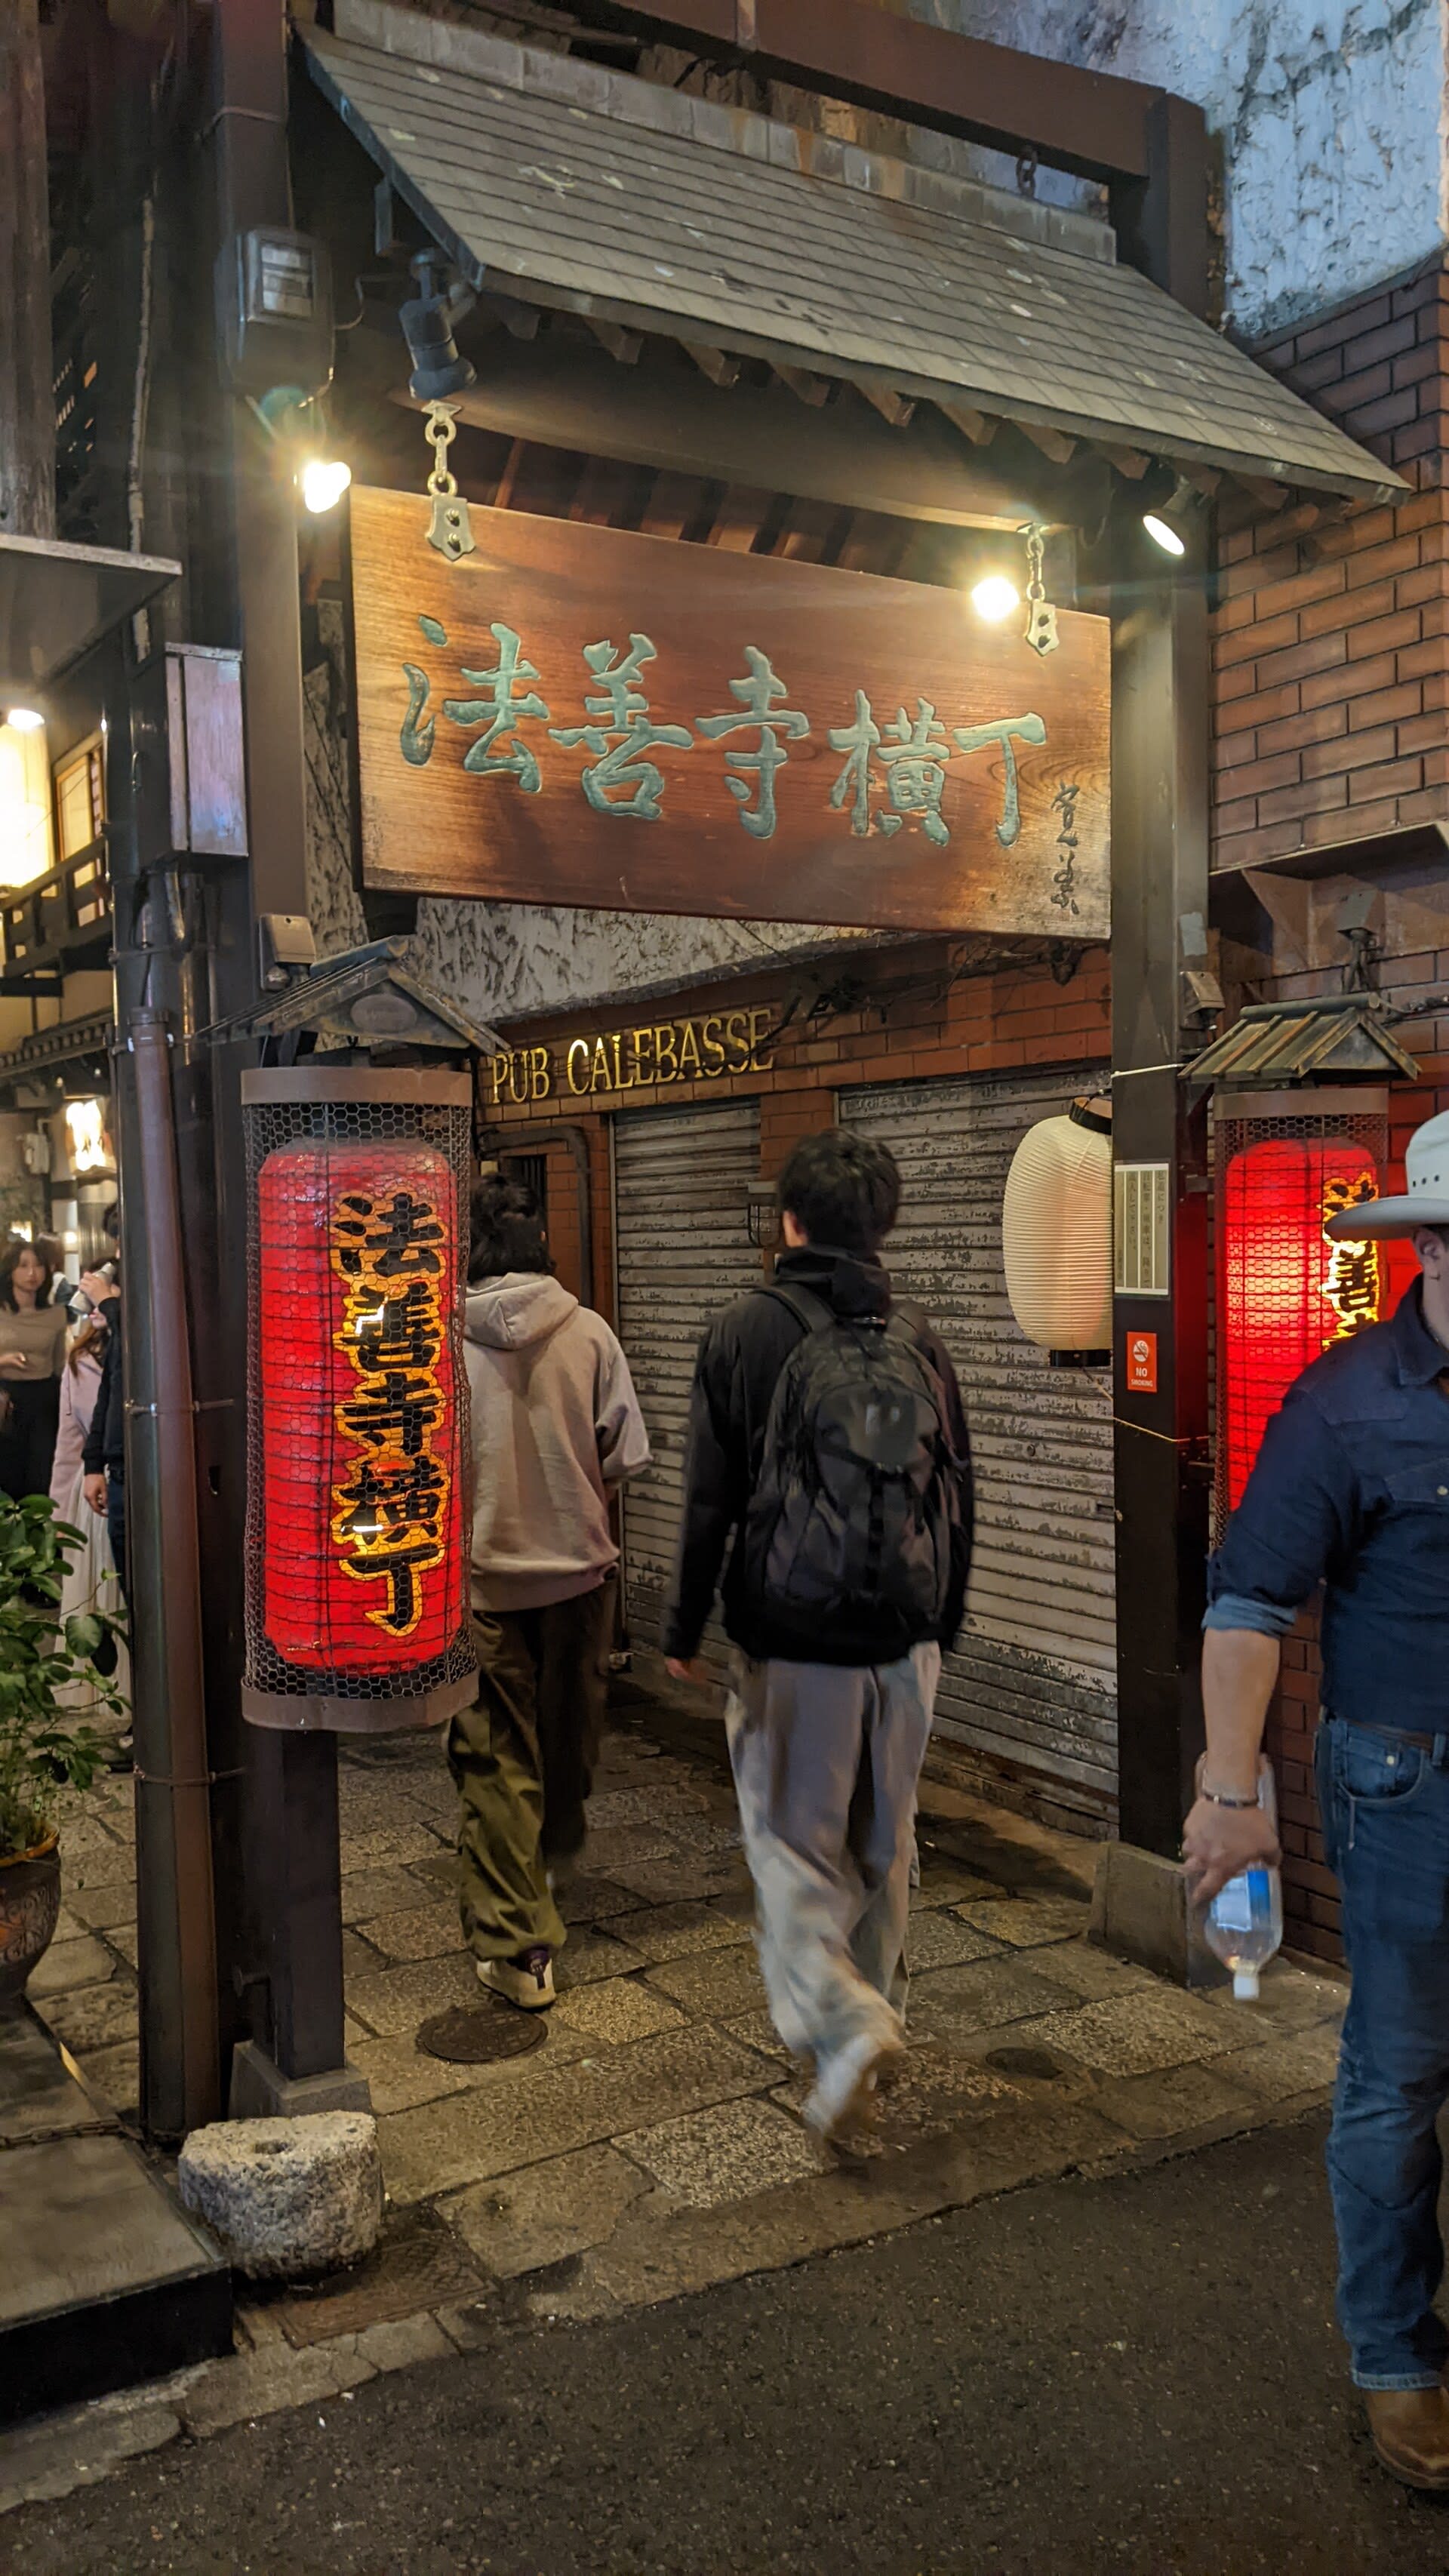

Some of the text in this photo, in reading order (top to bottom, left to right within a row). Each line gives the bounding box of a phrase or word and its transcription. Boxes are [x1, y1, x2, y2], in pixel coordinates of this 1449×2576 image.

[399, 614, 1047, 848] 法善寺横丁
[491, 1008, 774, 1104] PUB CALEBASSE
[332, 1190, 447, 1633] 法善寺横丁
[1135, 1367, 1148, 1377] NO
